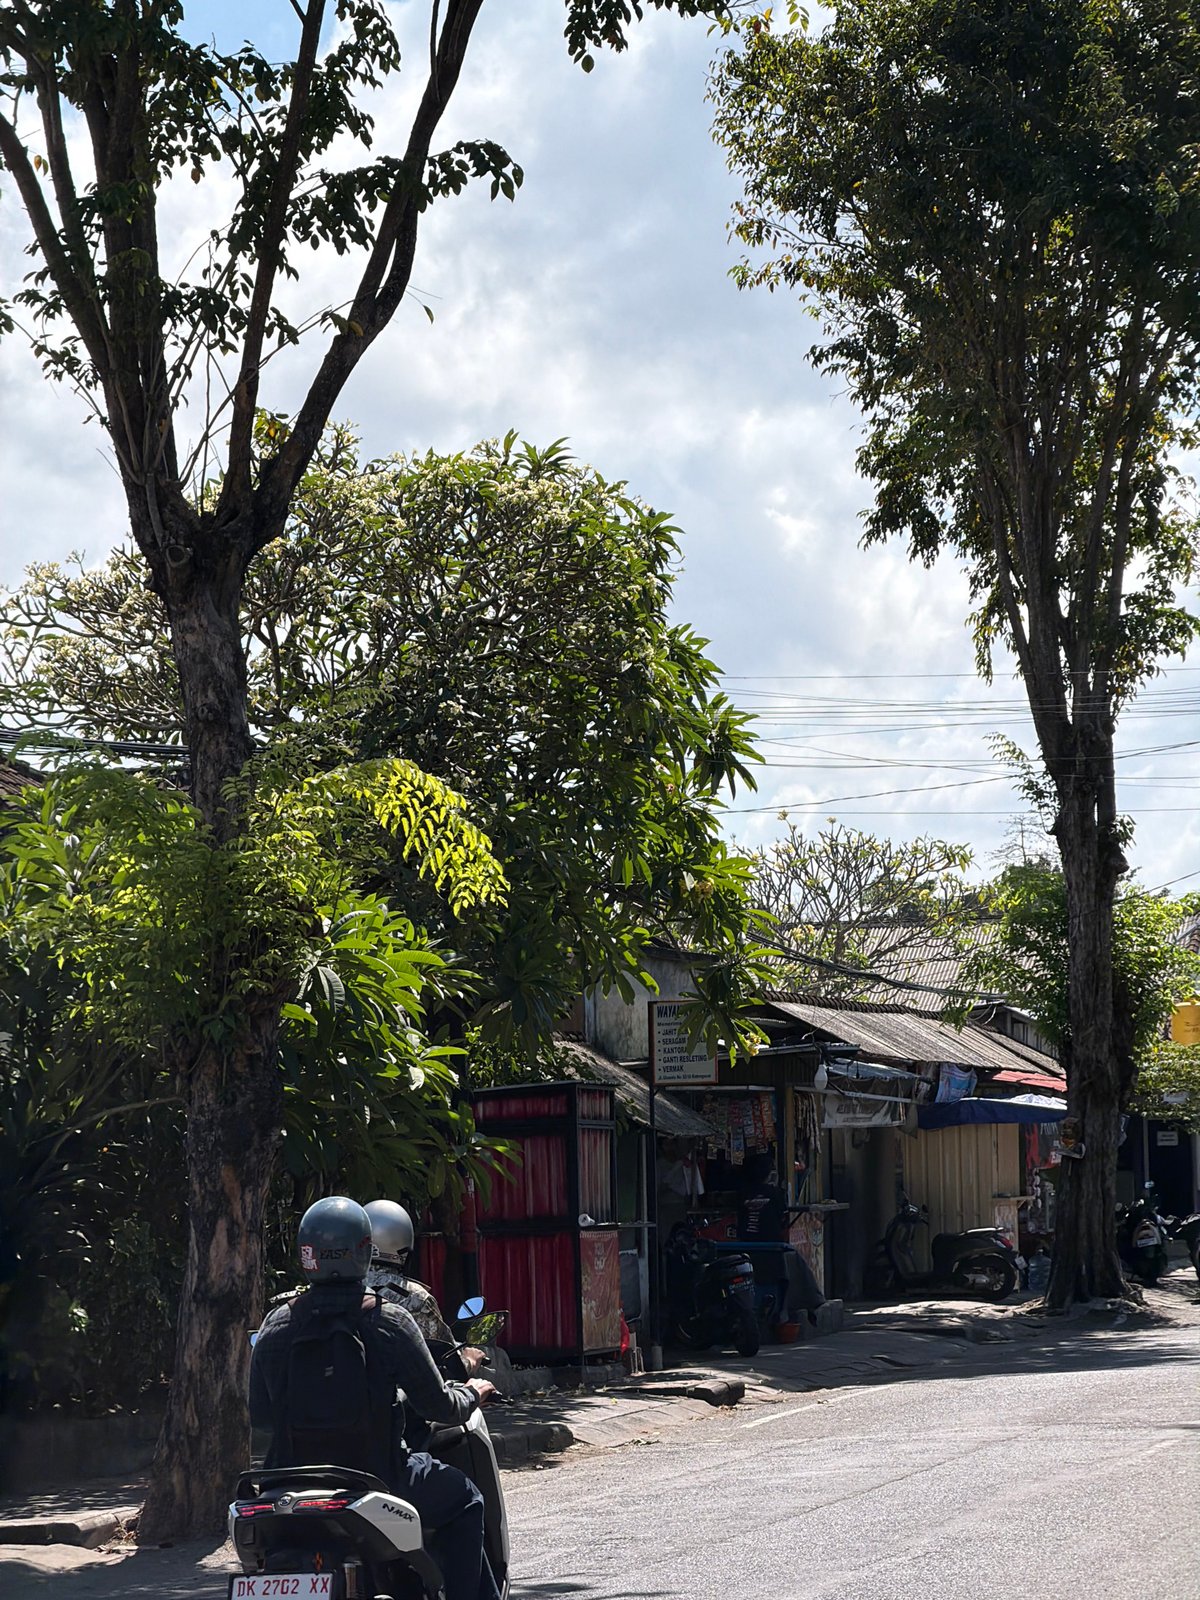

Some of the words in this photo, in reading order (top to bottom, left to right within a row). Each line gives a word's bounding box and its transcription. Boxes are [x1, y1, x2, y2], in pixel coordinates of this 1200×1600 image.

[662, 1028, 676, 1036] JAHIT
[662, 1037, 686, 1045] SERAGAM
[679, 1054, 707, 1063] RESLETING
[663, 1065, 684, 1073] VERMAK
[382, 1502, 415, 1523] NMAX
[237, 1580, 256, 1597] DK
[262, 1578, 300, 1596] 2702
[309, 1577, 330, 1594] XX
